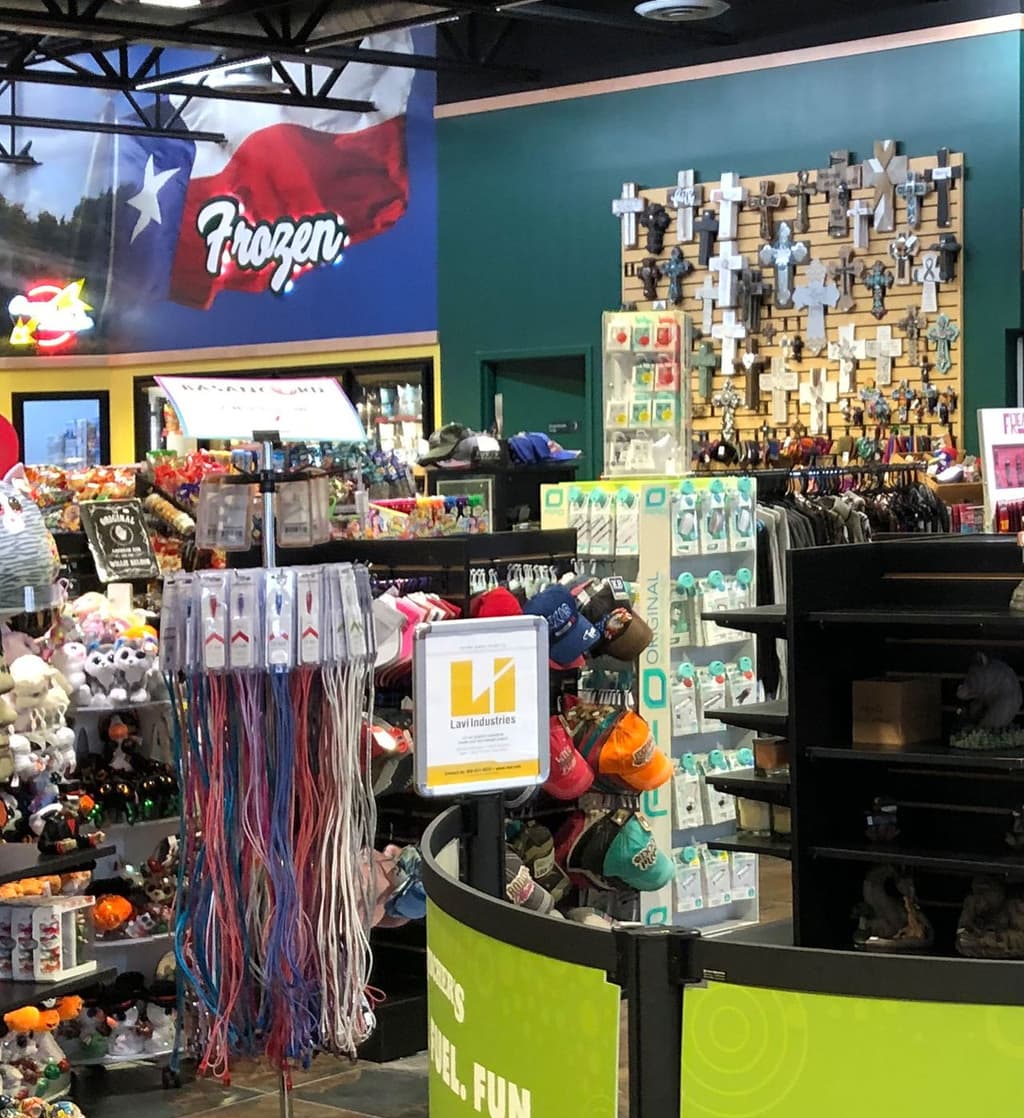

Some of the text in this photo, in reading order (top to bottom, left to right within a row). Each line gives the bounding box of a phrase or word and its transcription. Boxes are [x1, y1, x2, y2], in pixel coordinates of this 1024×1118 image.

[197, 199, 344, 292] Frozen
[450, 715, 516, 730] Lavi Industries
